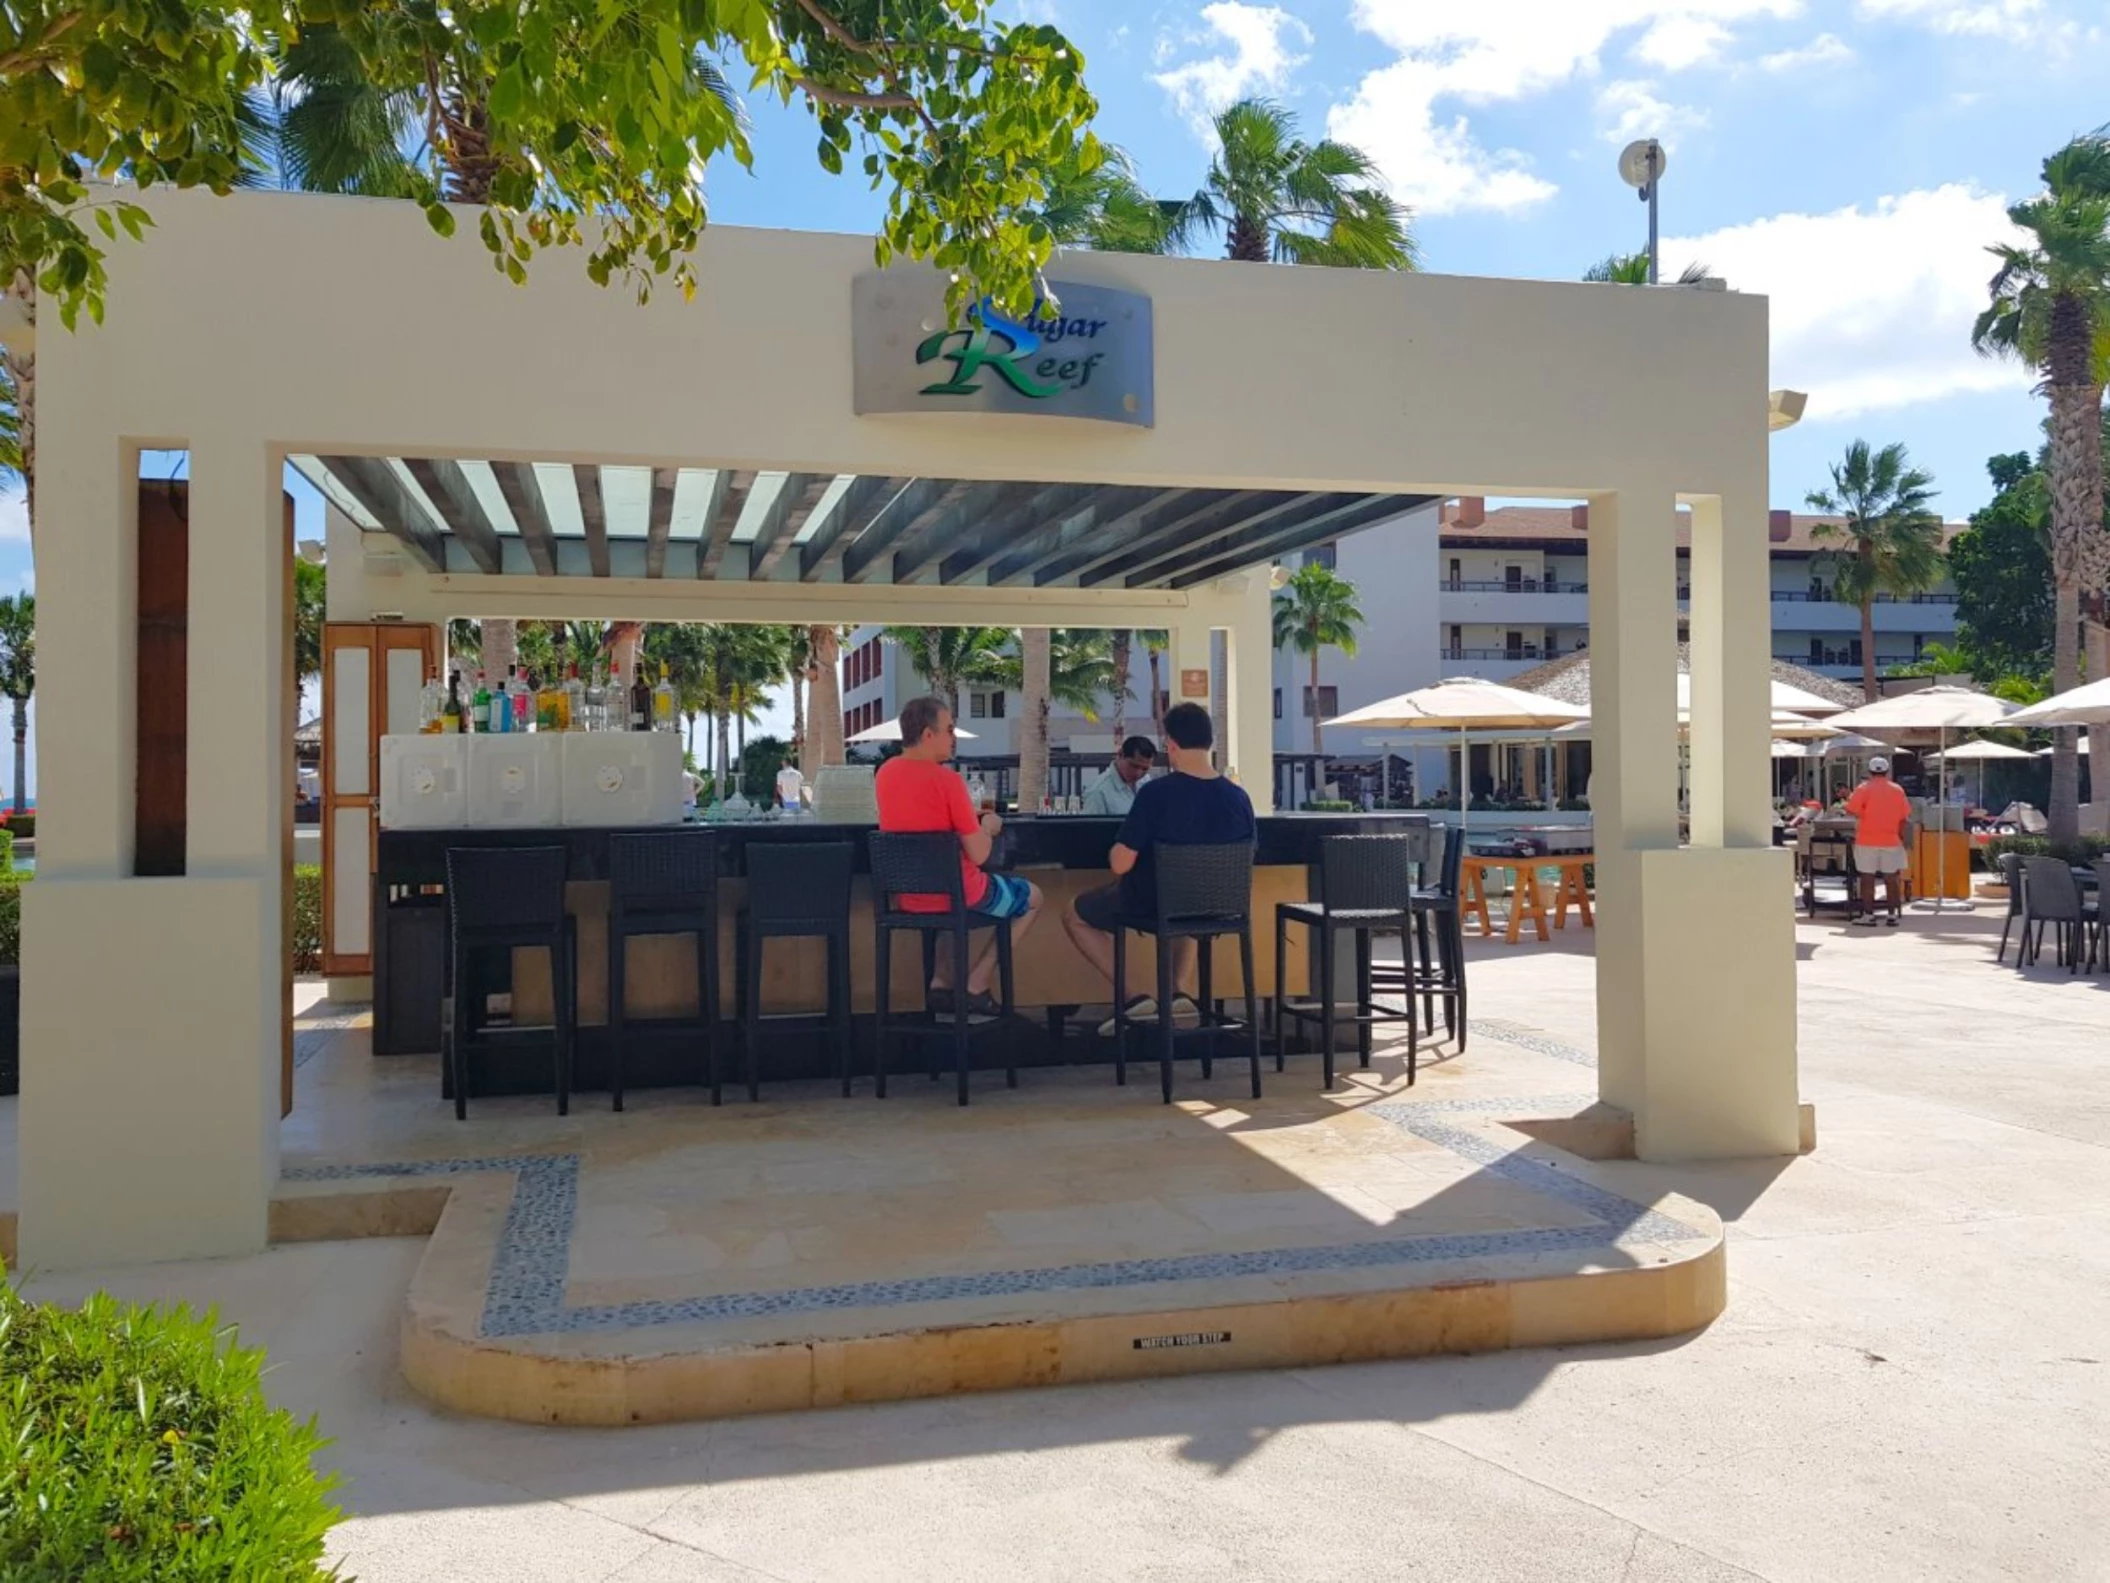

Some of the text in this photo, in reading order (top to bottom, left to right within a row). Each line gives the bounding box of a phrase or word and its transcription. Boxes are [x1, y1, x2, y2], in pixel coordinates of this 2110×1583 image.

[966, 296, 1109, 360] Sugar
[916, 330, 1105, 398] Reef
[1141, 1332, 1223, 1349] WATCH YOUR STEP
